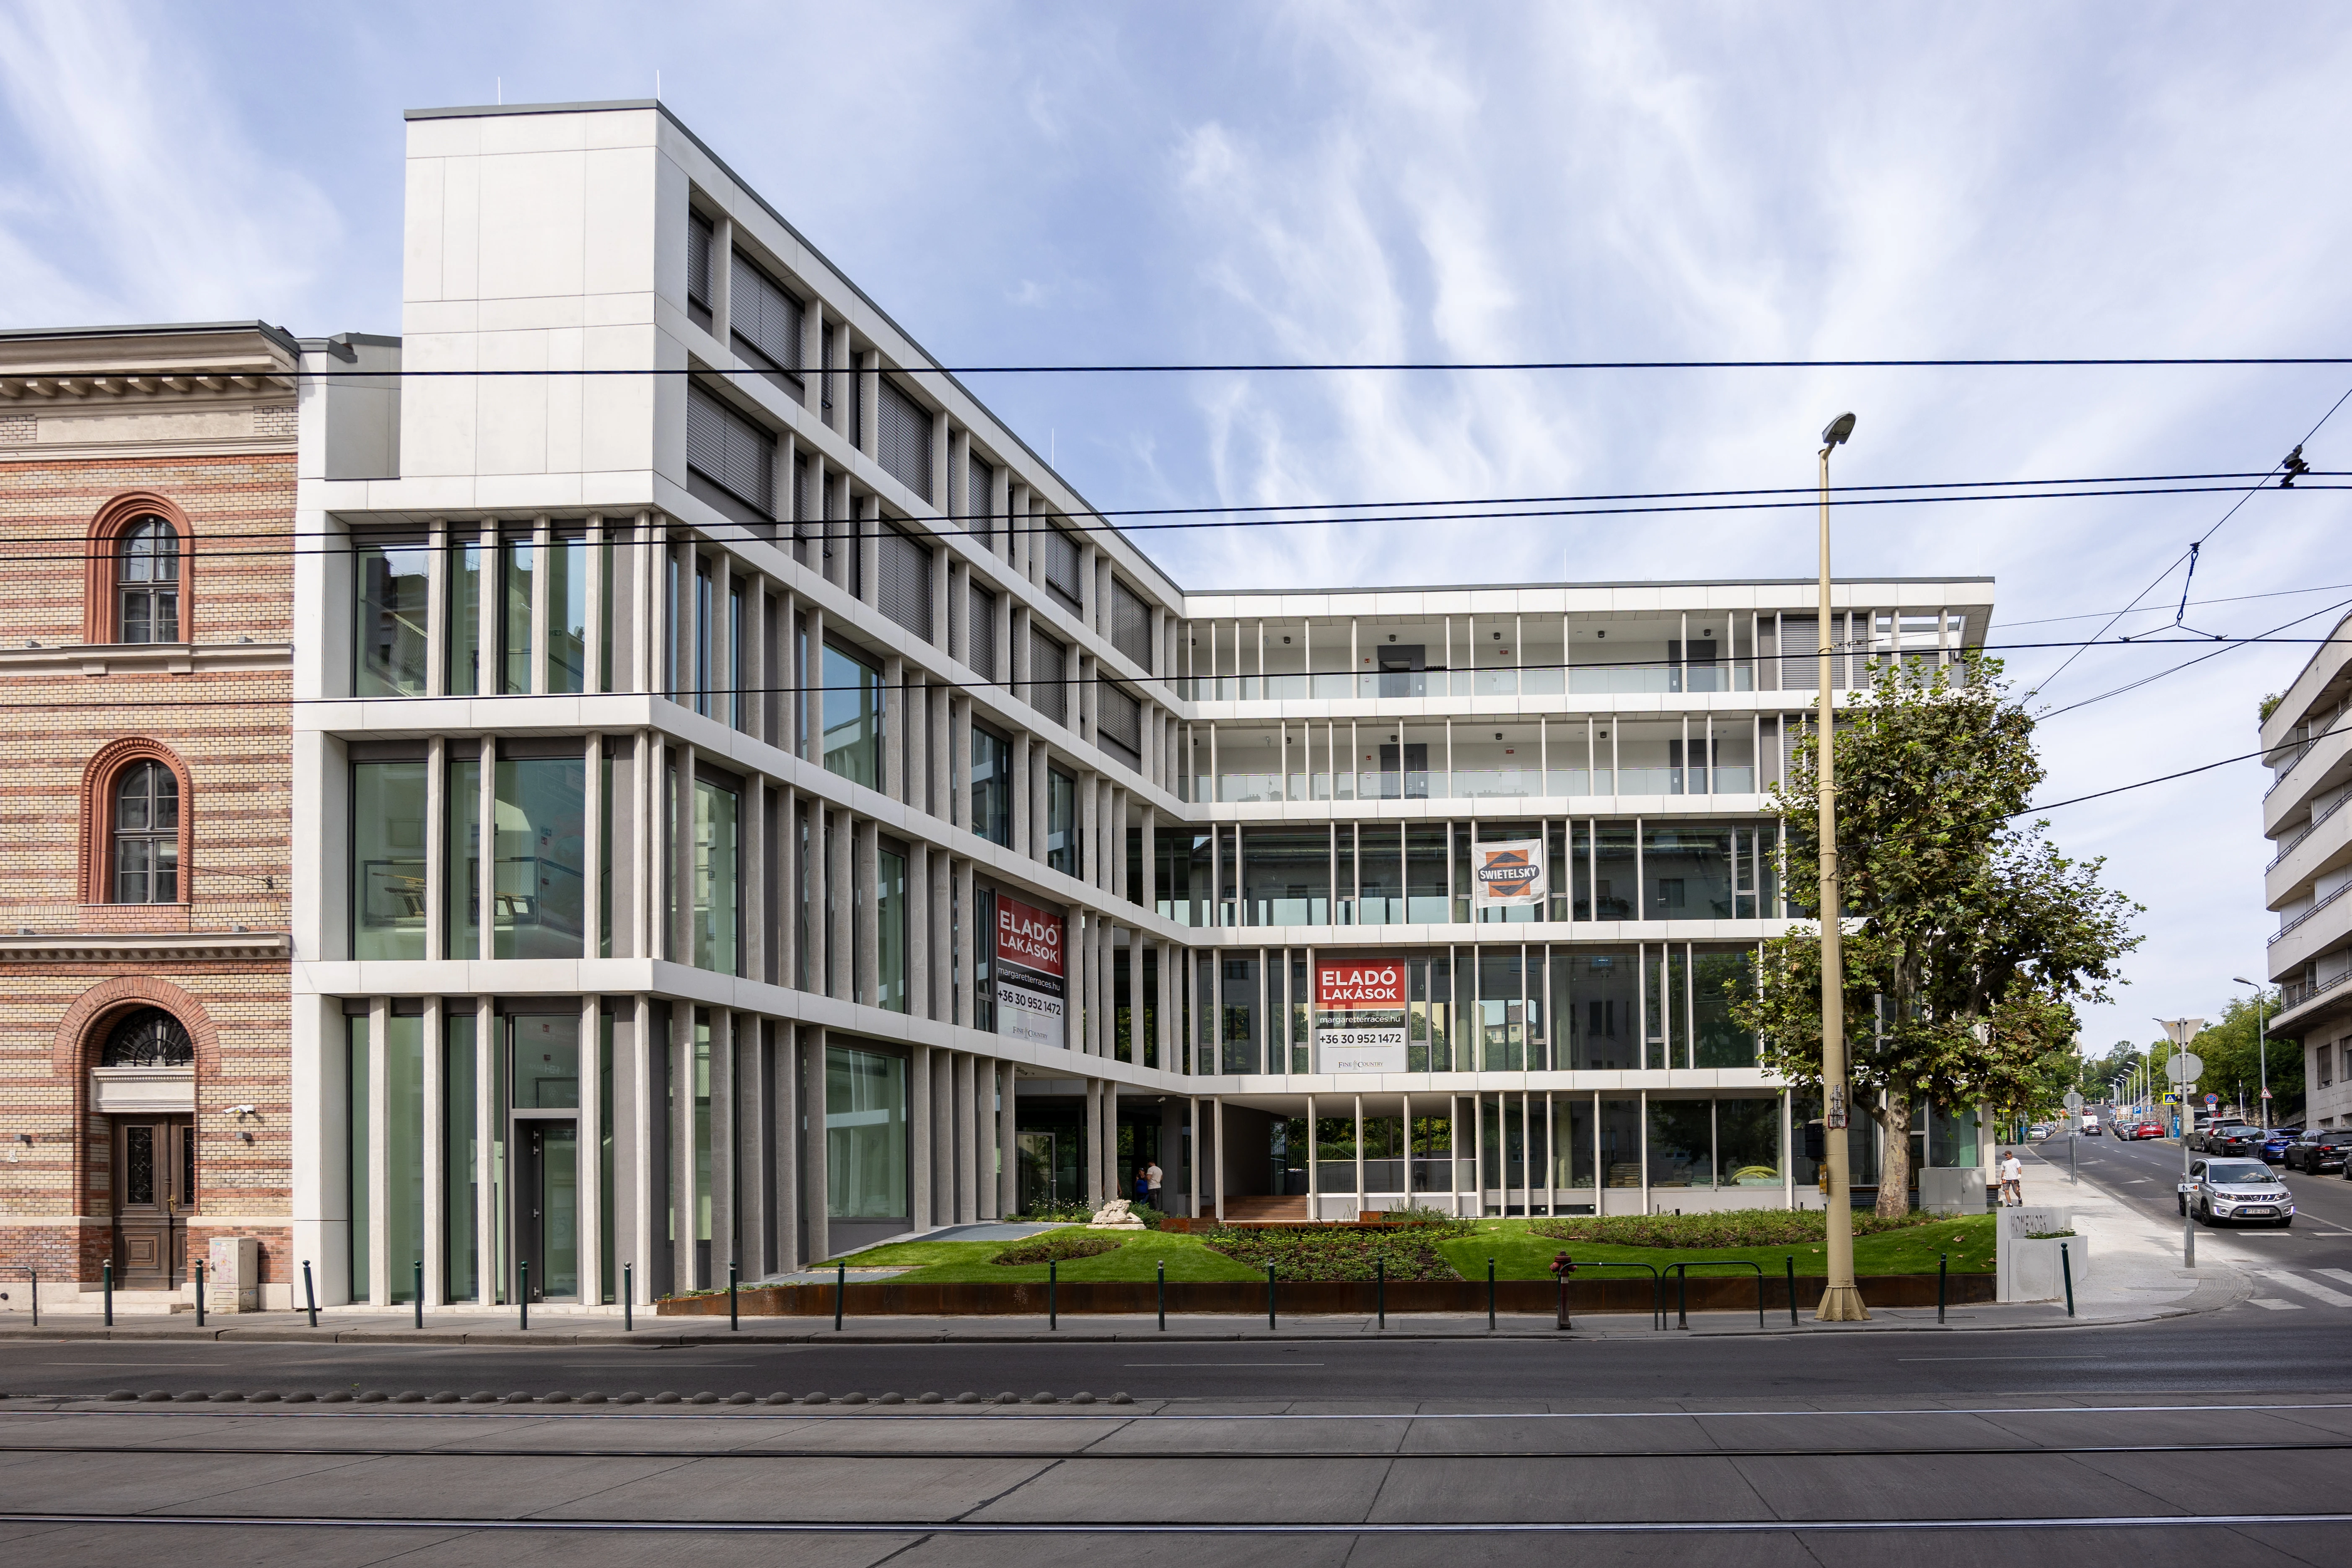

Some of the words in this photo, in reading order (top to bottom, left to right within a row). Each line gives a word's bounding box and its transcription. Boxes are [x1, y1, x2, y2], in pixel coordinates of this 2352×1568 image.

[1480, 867, 1537, 880] SWIETELSKY
[1000, 910, 1057, 946] ELADÓ
[1000, 932, 1057, 963] LAKÁSOK
[998, 967, 1060, 991] margaretterraces.hu
[1322, 966, 1396, 986] ELADÓ
[1323, 985, 1397, 1000] LAKÁSOK
[997, 990, 1013, 1003] +36
[1015, 993, 1026, 1006] 30
[1027, 997, 1042, 1011] 952
[1044, 1001, 1061, 1015] 1472
[1320, 1015, 1400, 1024] margaretterraces.hu
[1320, 1034, 1338, 1044] +36
[1341, 1034, 1354, 1044] 30
[1357, 1034, 1376, 1044] 952
[1378, 1034, 1401, 1043] 1472
[2011, 1215, 2047, 1234] HOMEWORK
